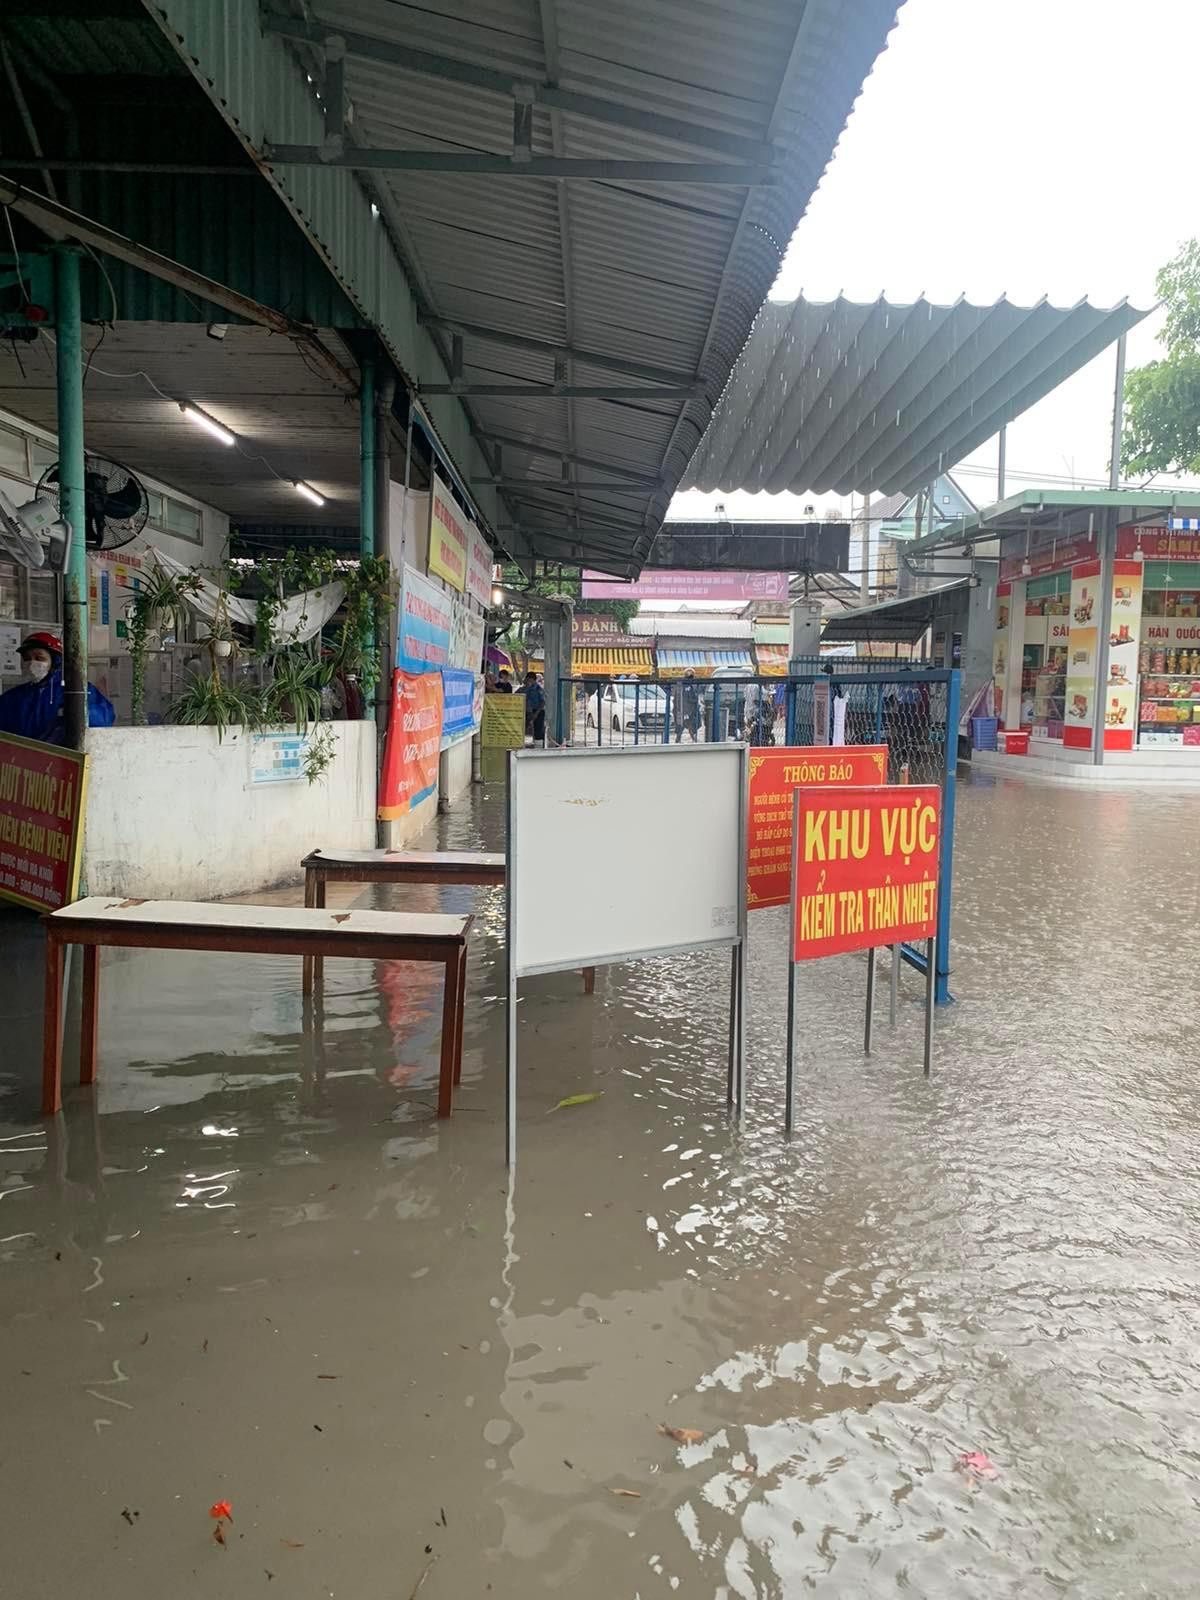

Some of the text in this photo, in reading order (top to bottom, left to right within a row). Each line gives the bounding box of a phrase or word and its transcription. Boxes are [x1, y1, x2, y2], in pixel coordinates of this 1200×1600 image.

[22, 761, 57, 815] THUỐC
[57, 773, 73, 821] LÁ
[783, 758, 853, 783] THÔNG BÁO
[19, 817, 45, 854] BỆNH
[47, 827, 70, 865] VIỆN
[805, 797, 937, 866] KHU VỰC
[801, 869, 936, 941] KIỂM TRA THÂN NHIỆT
